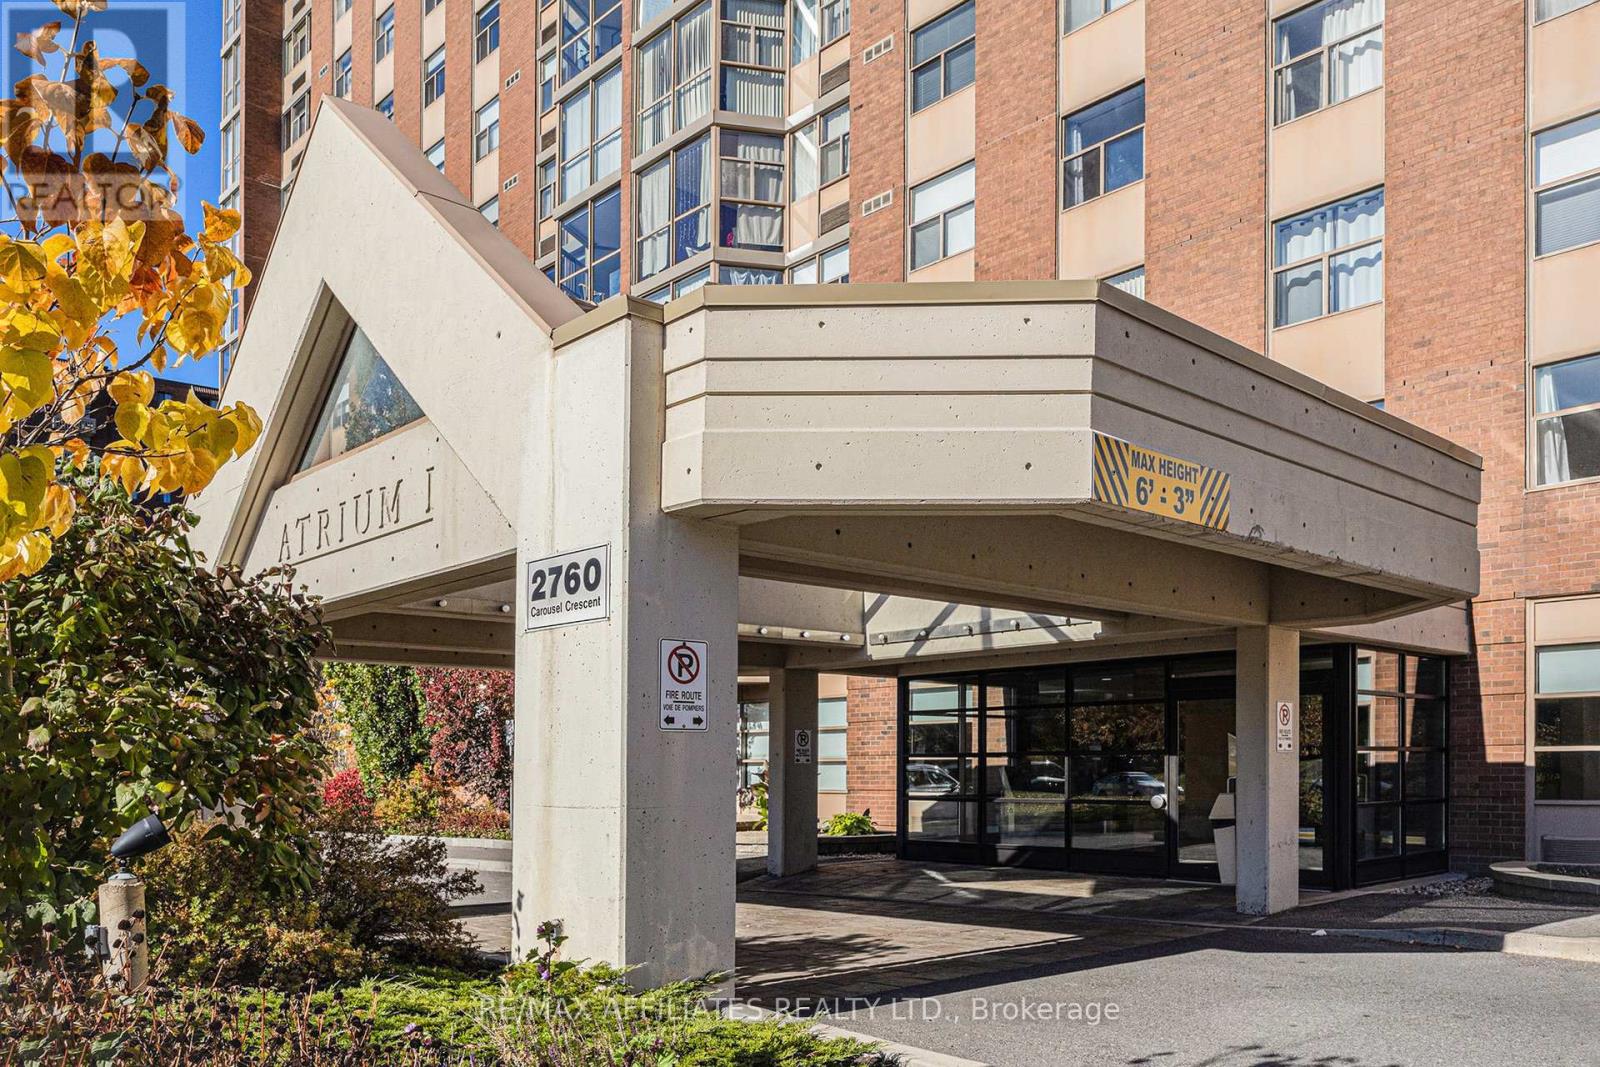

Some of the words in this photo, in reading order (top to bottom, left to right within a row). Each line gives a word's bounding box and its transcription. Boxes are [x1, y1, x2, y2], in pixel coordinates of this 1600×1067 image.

[1131, 450, 1155, 473] MAX
[1159, 457, 1199, 485] HEIGHT
[278, 478, 403, 563] ATRIUM
[425, 466, 435, 514] I
[531, 557, 602, 602] 2760
[530, 602, 563, 618] Carousel
[565, 596, 601, 612] Crescent
[665, 690, 679, 699] FIRE
[681, 691, 702, 700] ROUTE
